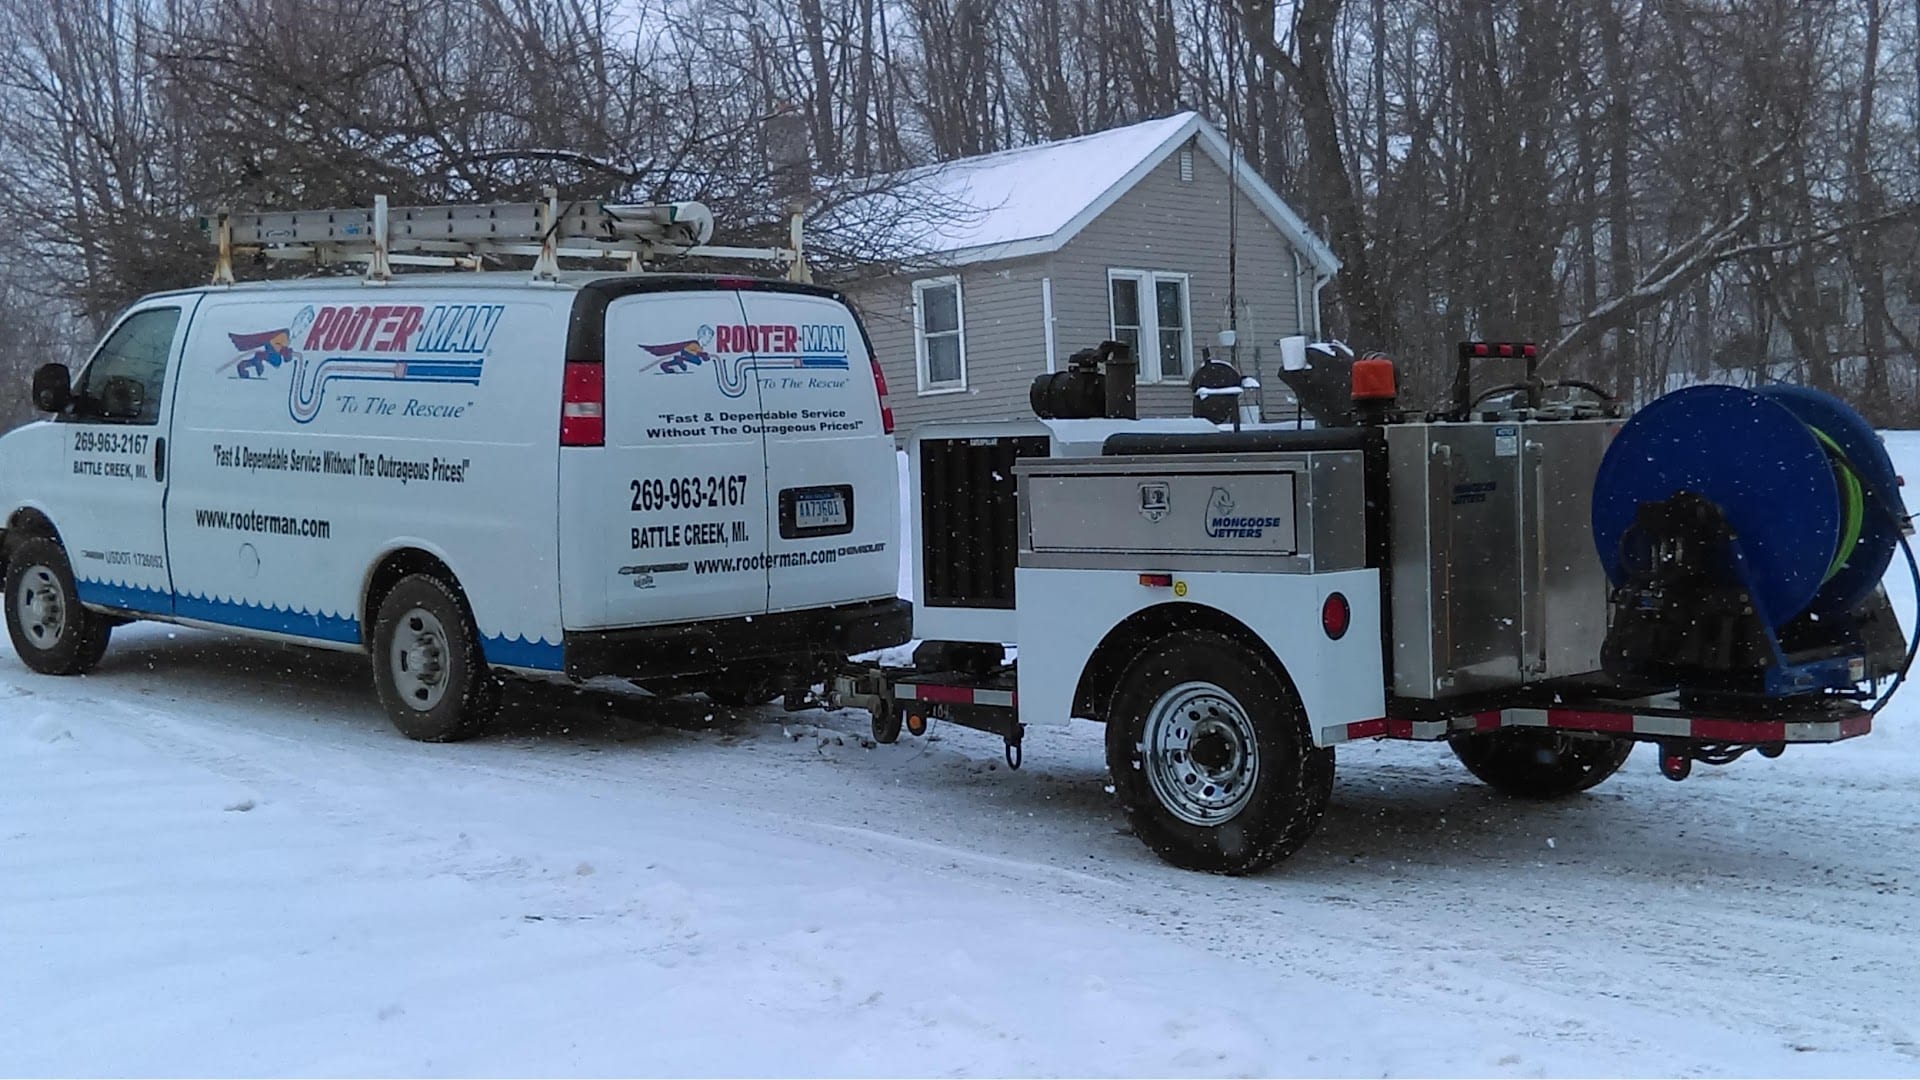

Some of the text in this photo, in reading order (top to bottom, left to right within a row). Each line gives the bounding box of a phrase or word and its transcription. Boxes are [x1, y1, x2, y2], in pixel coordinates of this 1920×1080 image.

[780, 378, 807, 389] The
[808, 378, 850, 389] Rescue"
[366, 397, 396, 416] The
[403, 398, 473, 419] Rescue"
[703, 412, 715, 423] &
[719, 410, 798, 423] Dependable
[801, 409, 846, 419] Service
[647, 424, 707, 439] Without
[710, 425, 738, 436] The
[742, 423, 816, 436] Outrageous
[74, 432, 149, 455] 269-963-2167
[73, 461, 148, 480] BATTLE CREEK, MI.
[234, 446, 241, 465] &
[242, 446, 289, 474] Dependable
[290, 450, 321, 472] Service
[323, 451, 356, 475] Without
[359, 453, 375, 477] The
[377, 454, 430, 485] Outrageous
[630, 475, 748, 511] 269-963-2167
[196, 509, 331, 539] www.rooterman.com
[1211, 528, 1262, 538] JETTERS
[1212, 517, 1280, 527] MONGOOSE
[631, 521, 749, 549] BATTLE CREEK, MI.
[694, 548, 837, 574] www.rooterman.com
